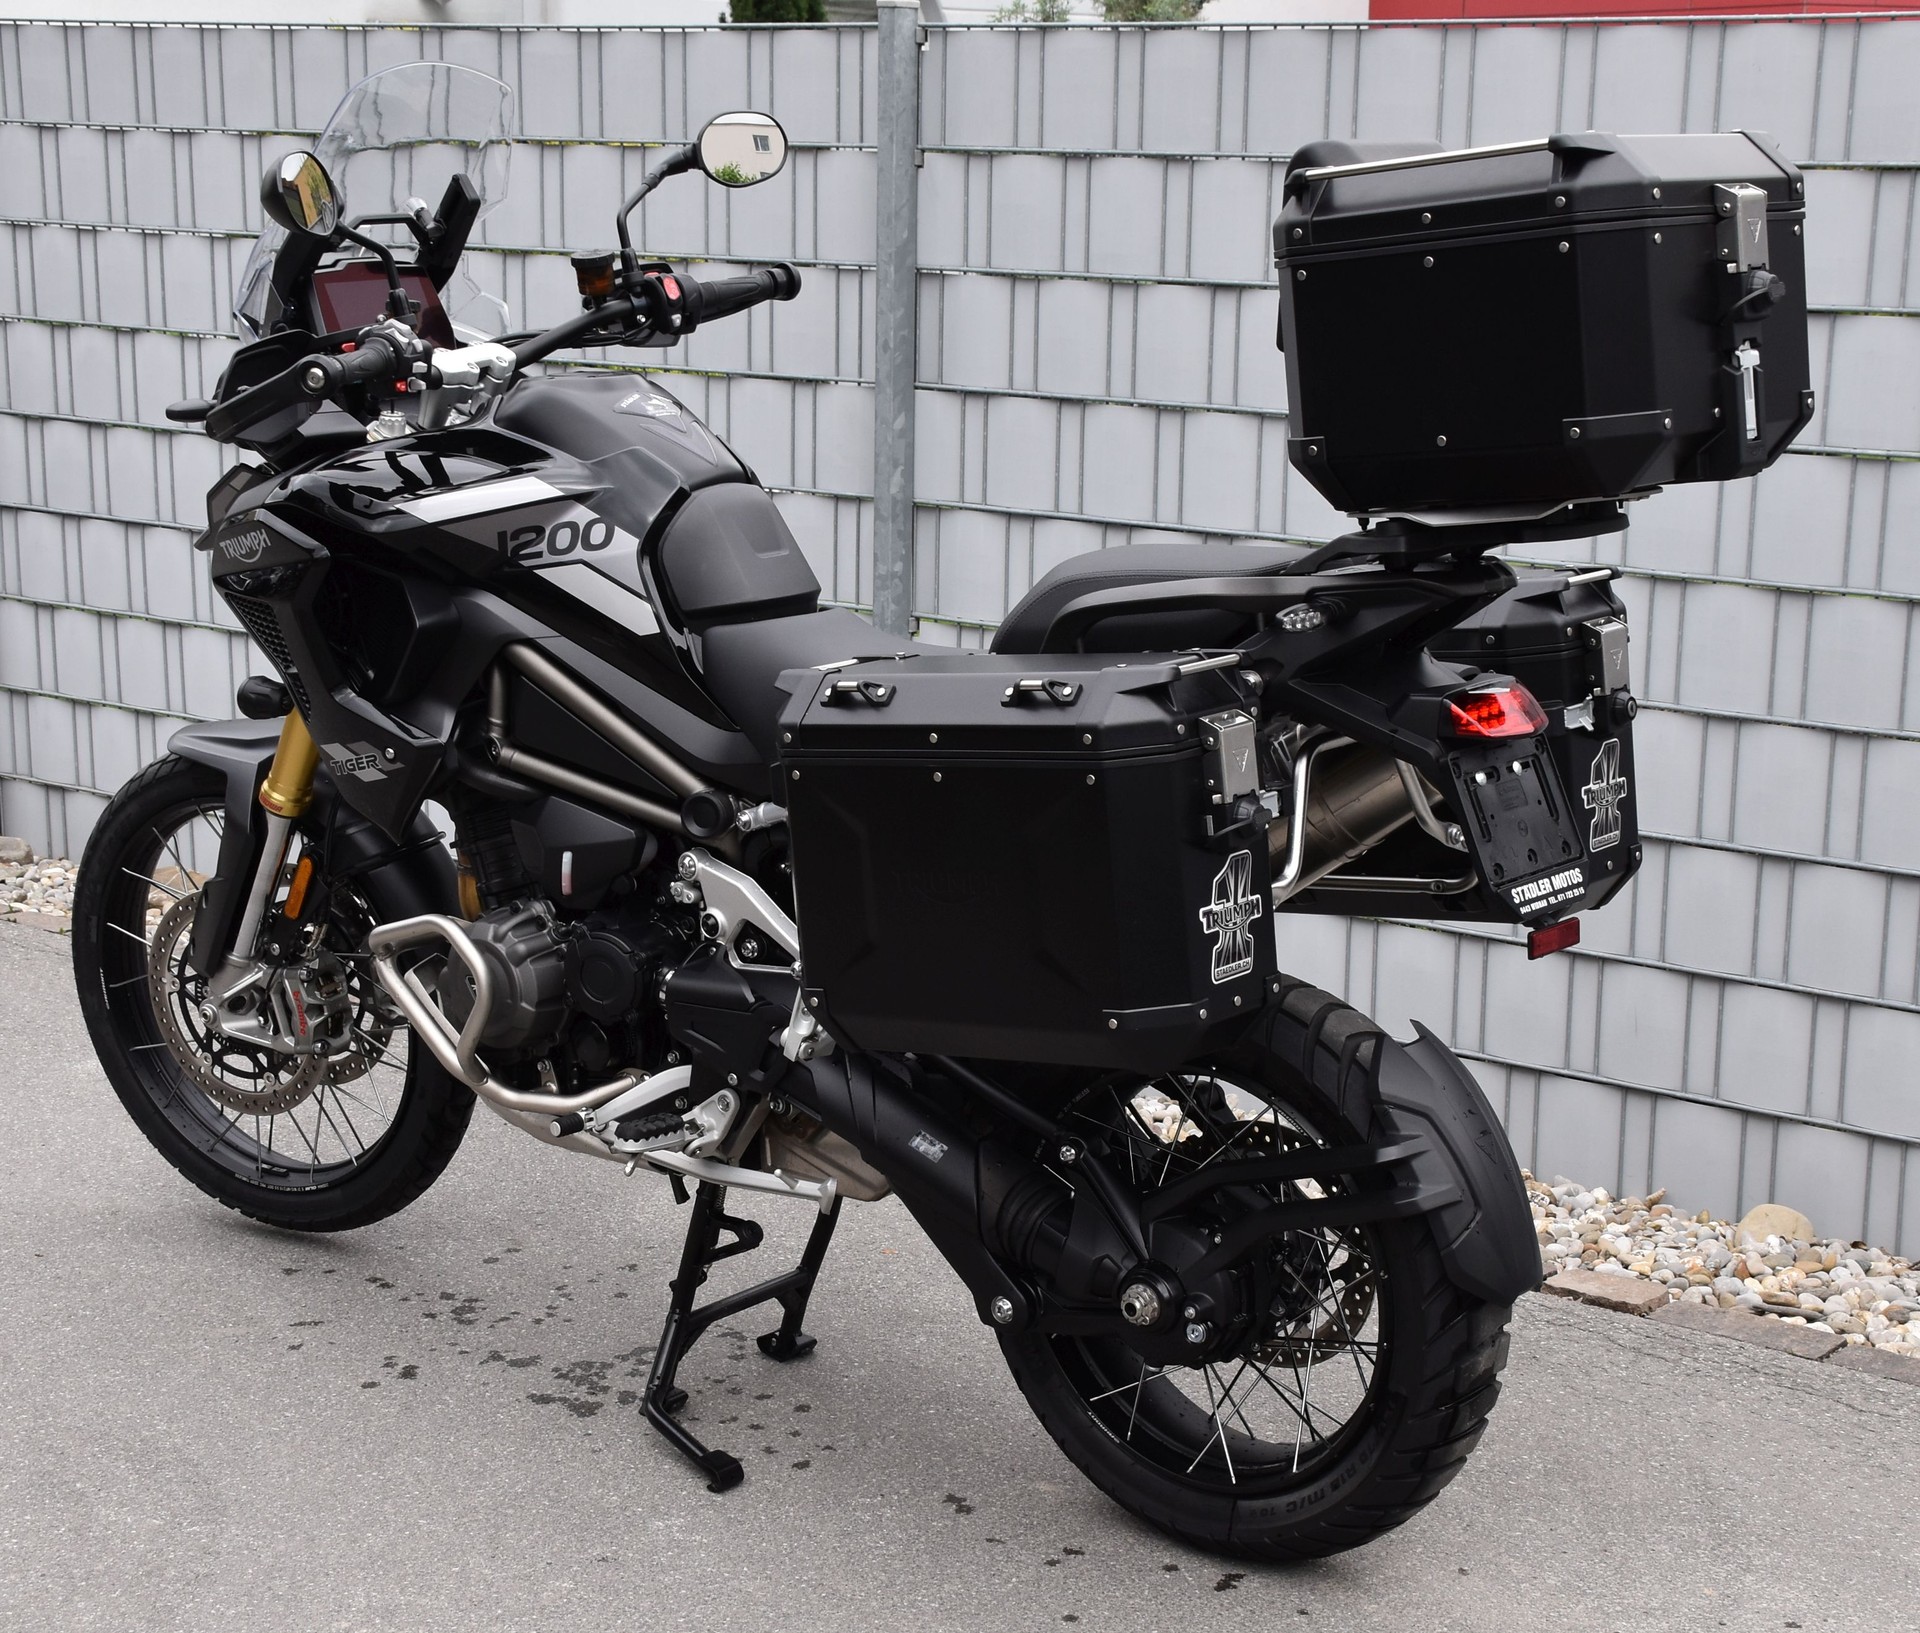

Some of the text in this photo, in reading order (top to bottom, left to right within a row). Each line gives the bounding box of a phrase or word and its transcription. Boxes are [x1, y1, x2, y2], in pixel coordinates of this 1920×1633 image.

[219, 528, 271, 562] TRIUMPH
[497, 517, 615, 561] 1200
[330, 753, 381, 775] TIGER
[1583, 778, 1626, 808] TRIUMPH
[1551, 867, 1583, 891] MOTOS
[1200, 895, 1261, 932] TRIUMPH
[1216, 960, 1250, 978] STAEDLER.CH
[293, 990, 306, 1036] brembo
